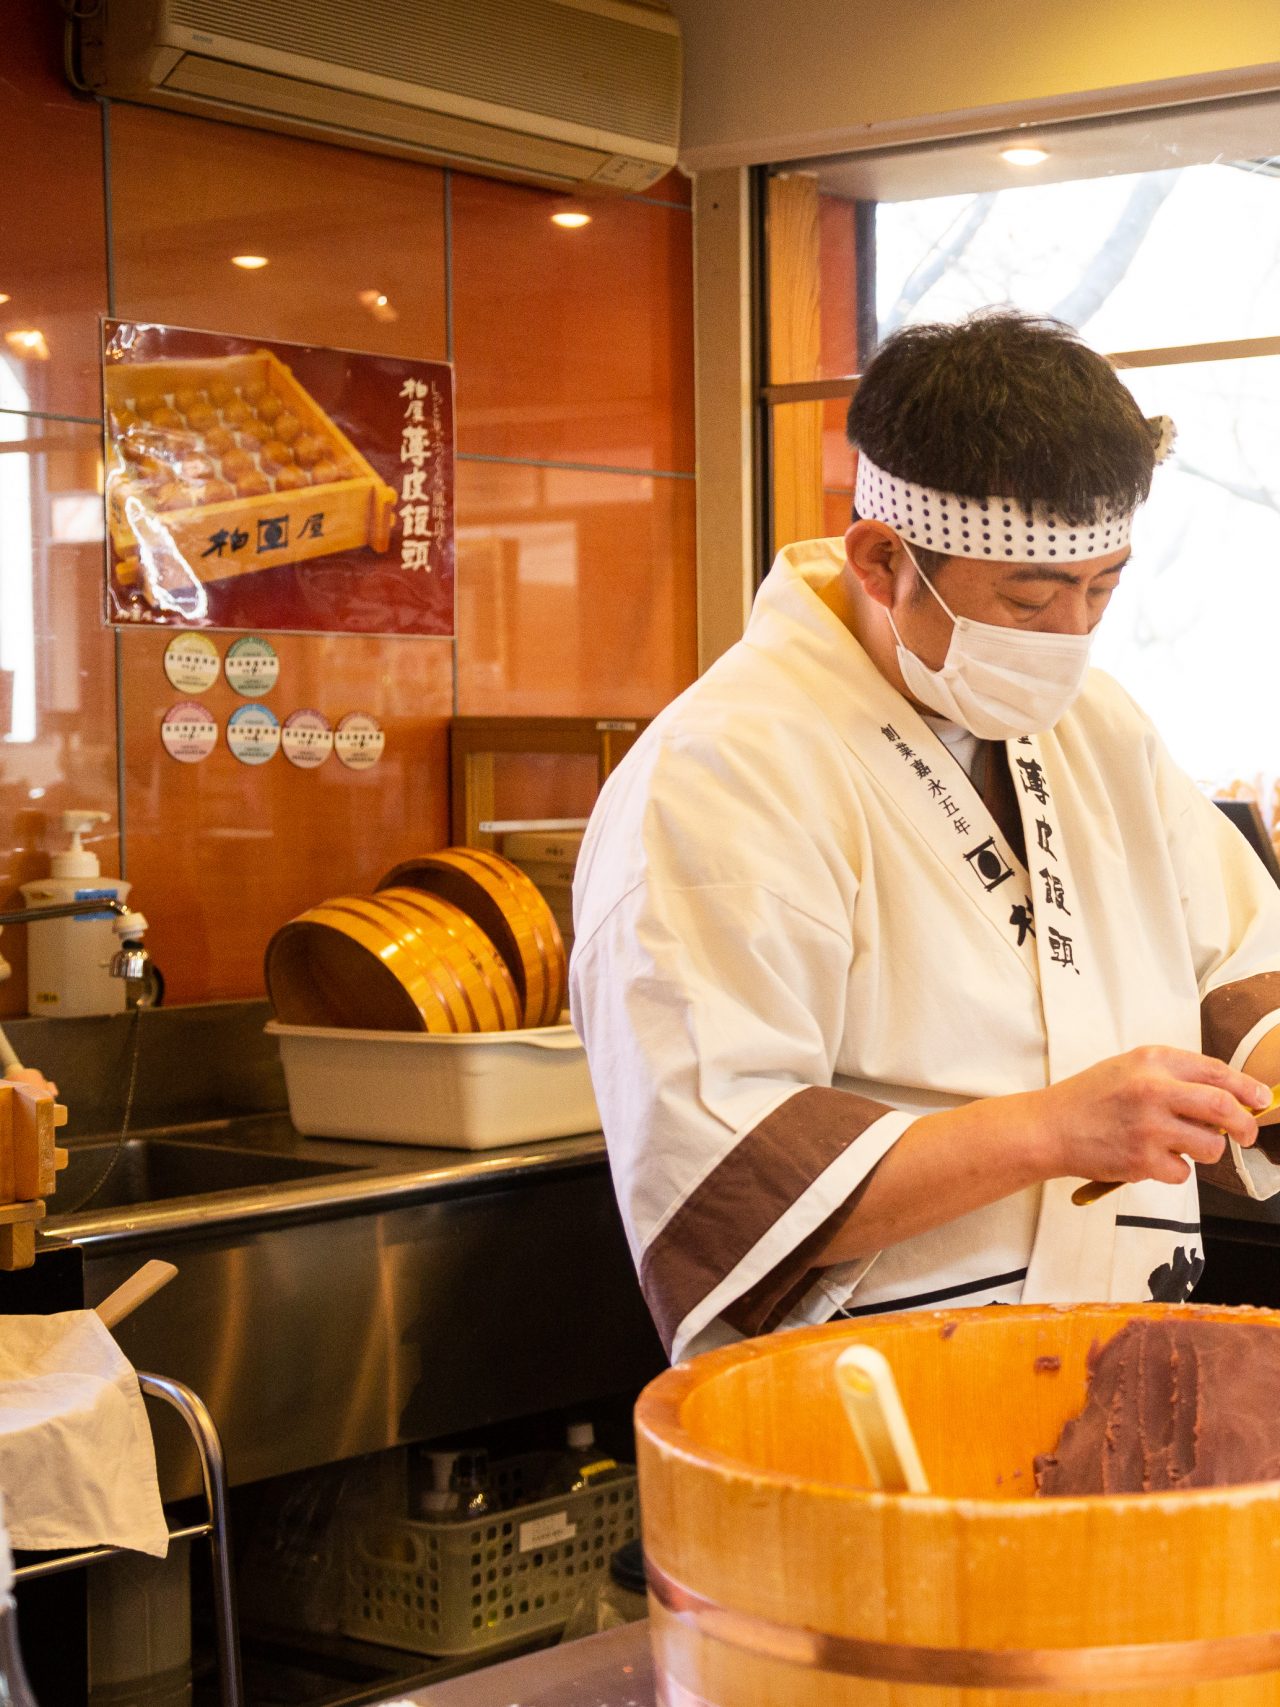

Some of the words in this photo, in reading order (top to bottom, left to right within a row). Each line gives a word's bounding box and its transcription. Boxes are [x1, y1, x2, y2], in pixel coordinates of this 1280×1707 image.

[880, 723, 971, 836] 創業嘉永五年
[1016, 756, 1080, 975] 薄皮饅頭
